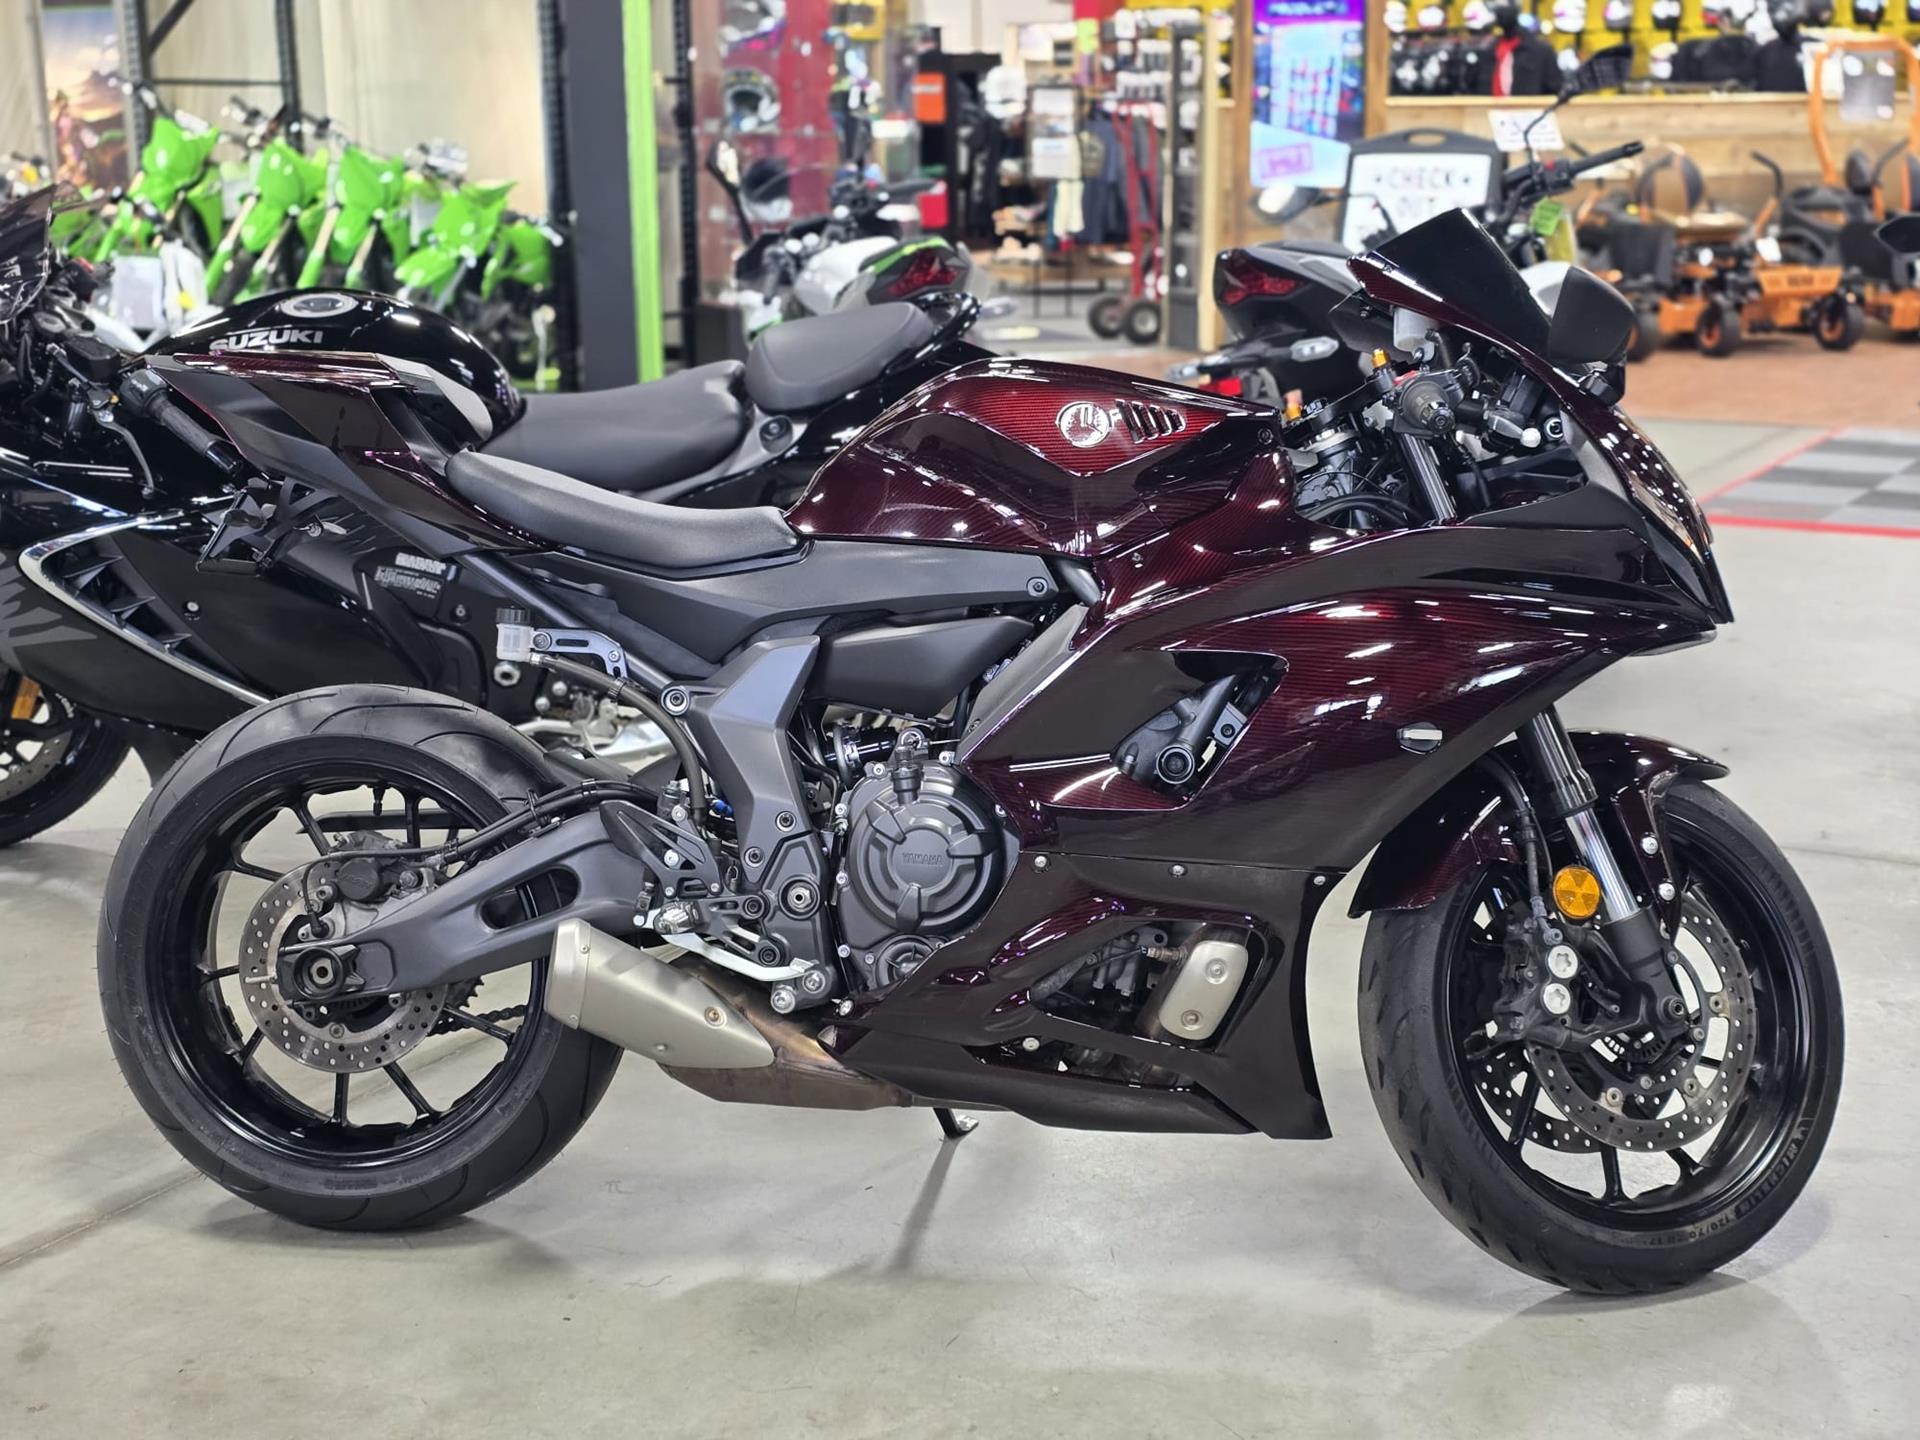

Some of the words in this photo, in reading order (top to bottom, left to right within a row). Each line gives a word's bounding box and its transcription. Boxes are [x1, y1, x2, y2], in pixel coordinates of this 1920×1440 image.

[209, 329, 323, 350] SUZUKI
[902, 852, 943, 866] YAMAHA
[1737, 1143, 1798, 1214] MICHELIN
[1689, 1216, 1730, 1239] 120/70
